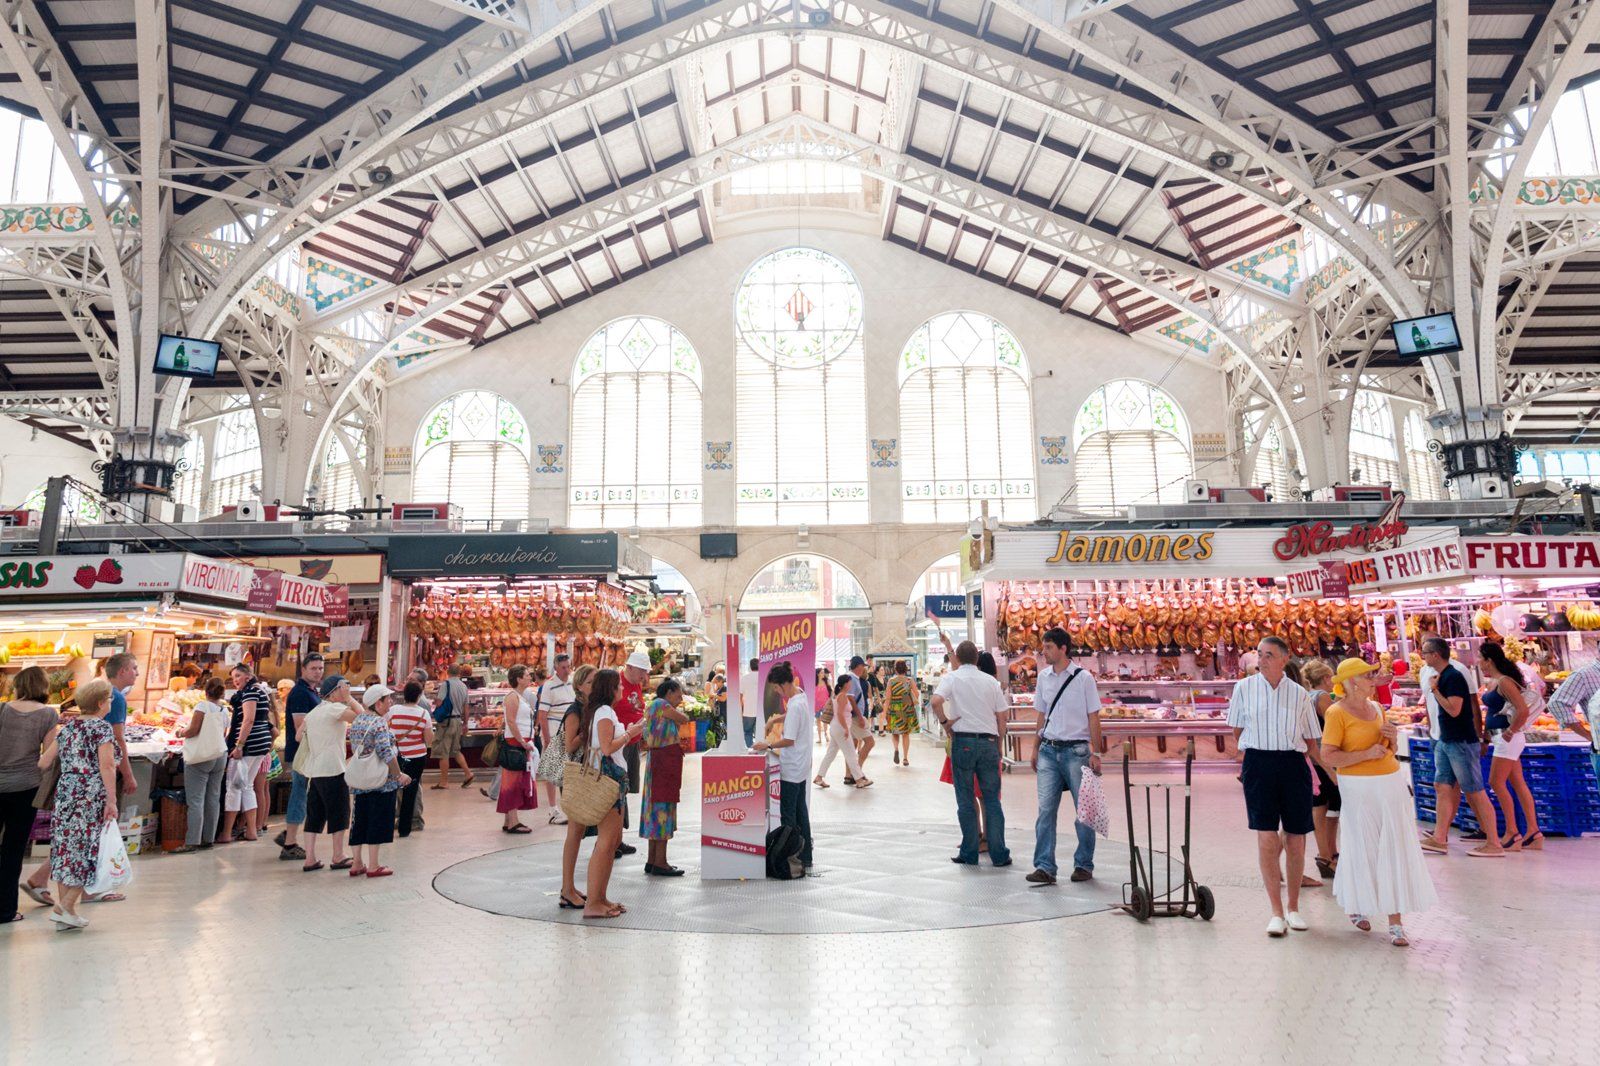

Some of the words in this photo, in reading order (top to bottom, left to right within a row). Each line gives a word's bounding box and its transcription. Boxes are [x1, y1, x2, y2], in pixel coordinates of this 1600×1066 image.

[444, 543, 557, 566] charcutería
[1046, 529, 1215, 563] Jamones
[1466, 542, 1600, 569] FRUTA
[1383, 544, 1463, 579] FRUTAS
[0, 561, 53, 589] SAS
[185, 560, 240, 594] VIRGINIA
[940, 600, 979, 612] Horcha
[761, 617, 812, 653] MANGO
[760, 653, 773, 663] SANO
[774, 651, 779, 660] Y
[778, 642, 803, 658] SABROSO
[704, 775, 763, 797] MANGO
[726, 790, 754, 801] SABROSO
[720, 808, 746, 821] TROPS
